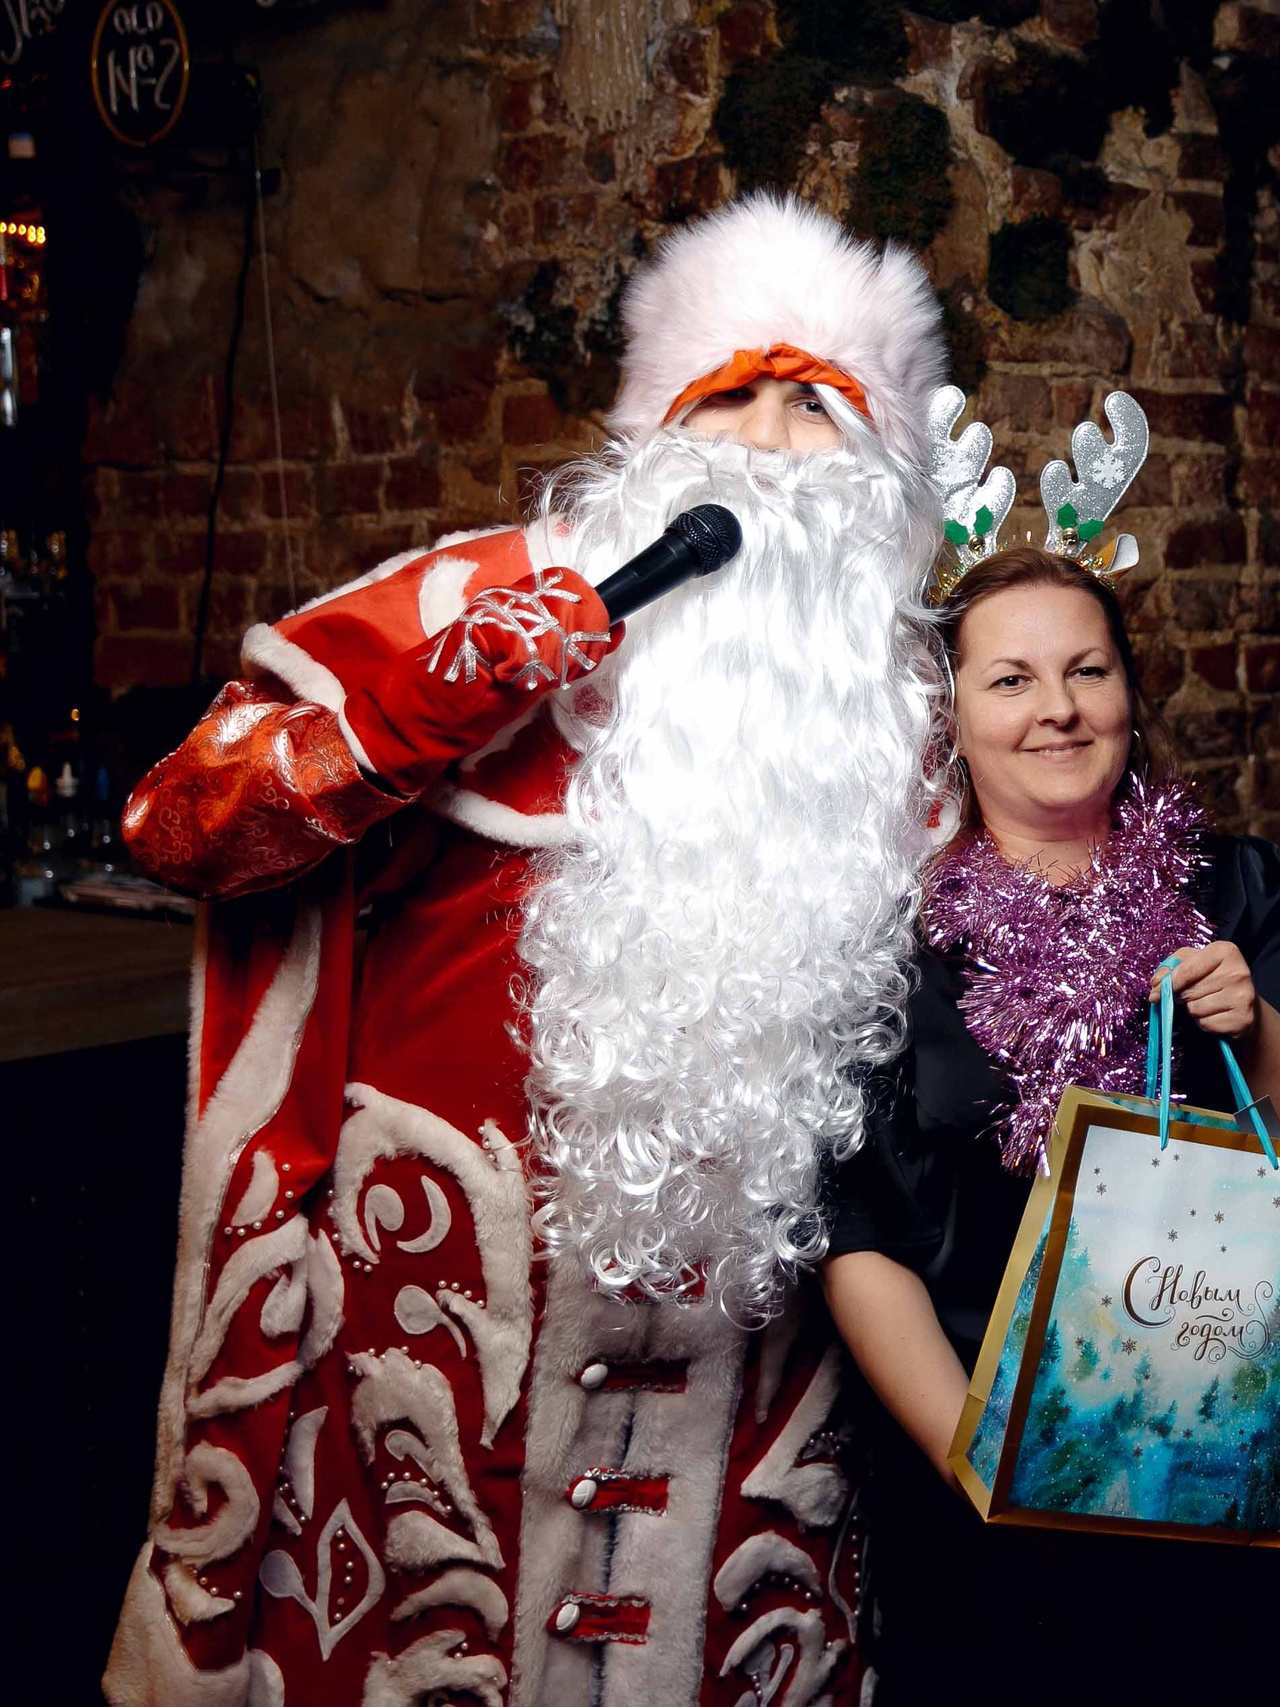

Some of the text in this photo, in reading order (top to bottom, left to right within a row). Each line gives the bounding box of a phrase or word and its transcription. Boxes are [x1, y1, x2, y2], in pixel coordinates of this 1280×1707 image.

[1122, 1256, 1254, 1329] С Новым
[1171, 1318, 1271, 1363] годом
